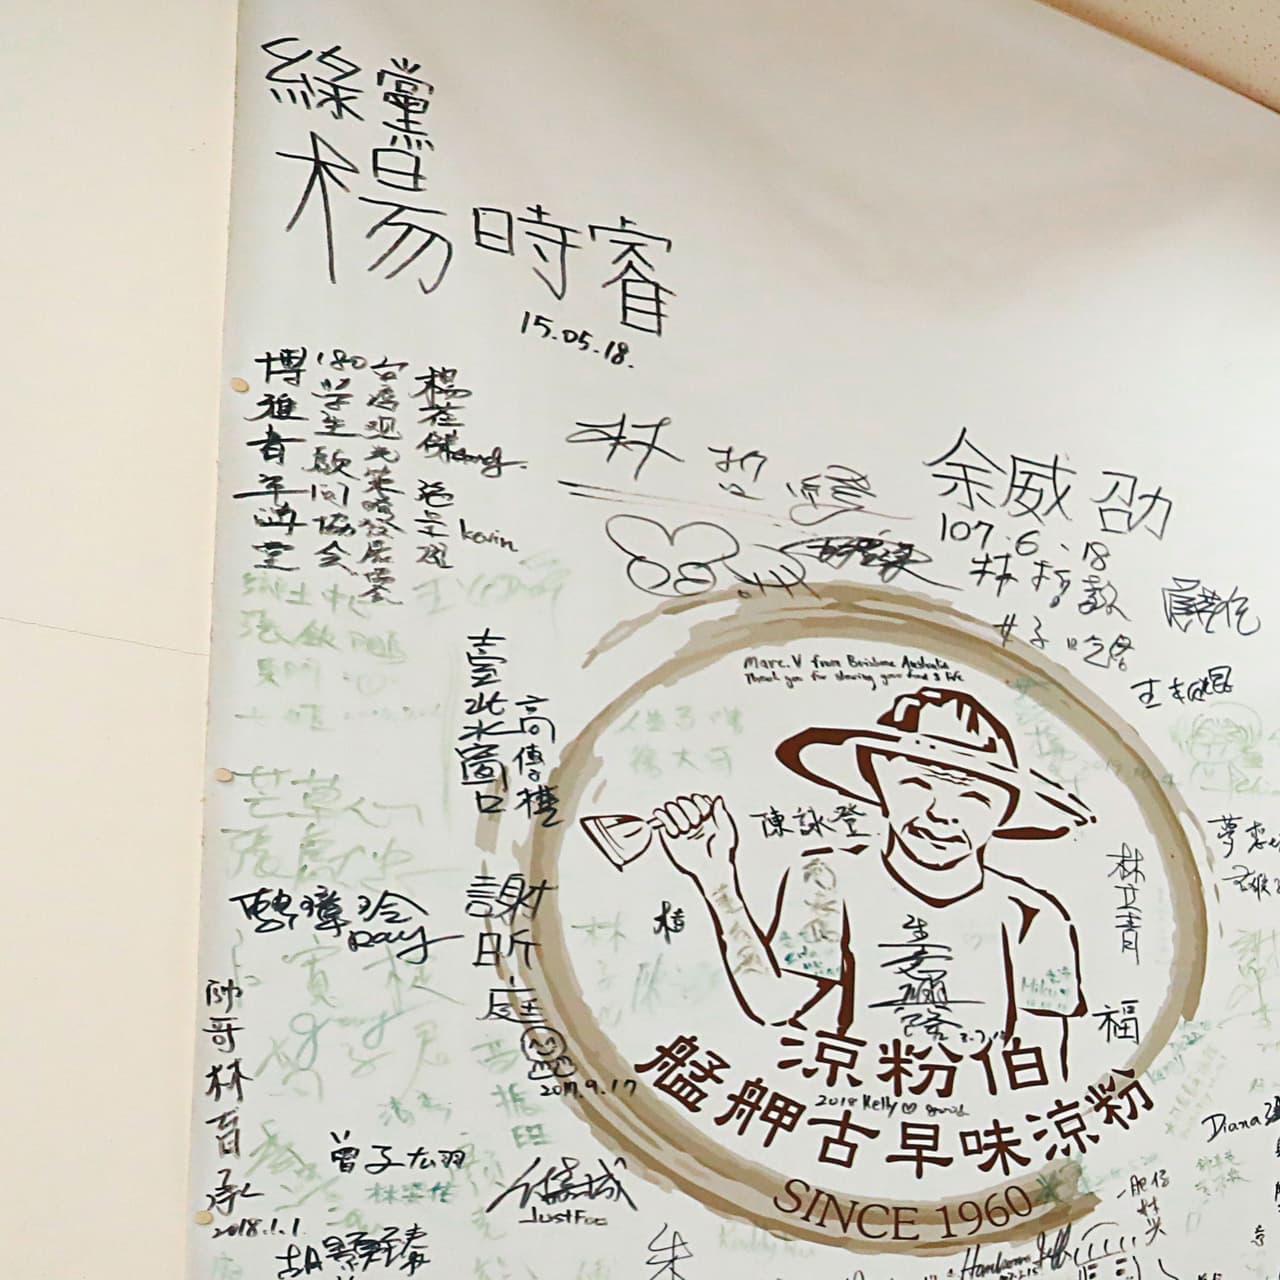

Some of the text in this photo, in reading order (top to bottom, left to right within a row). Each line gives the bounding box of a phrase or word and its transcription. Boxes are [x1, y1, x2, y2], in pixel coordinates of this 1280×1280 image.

[1092, 999, 1140, 1045] 福
[777, 1027, 1050, 1098] 涼粉伯
[634, 1033, 1156, 1179] 艋舺古早味涼粉
[773, 1178, 1035, 1241] SINCE 1960
